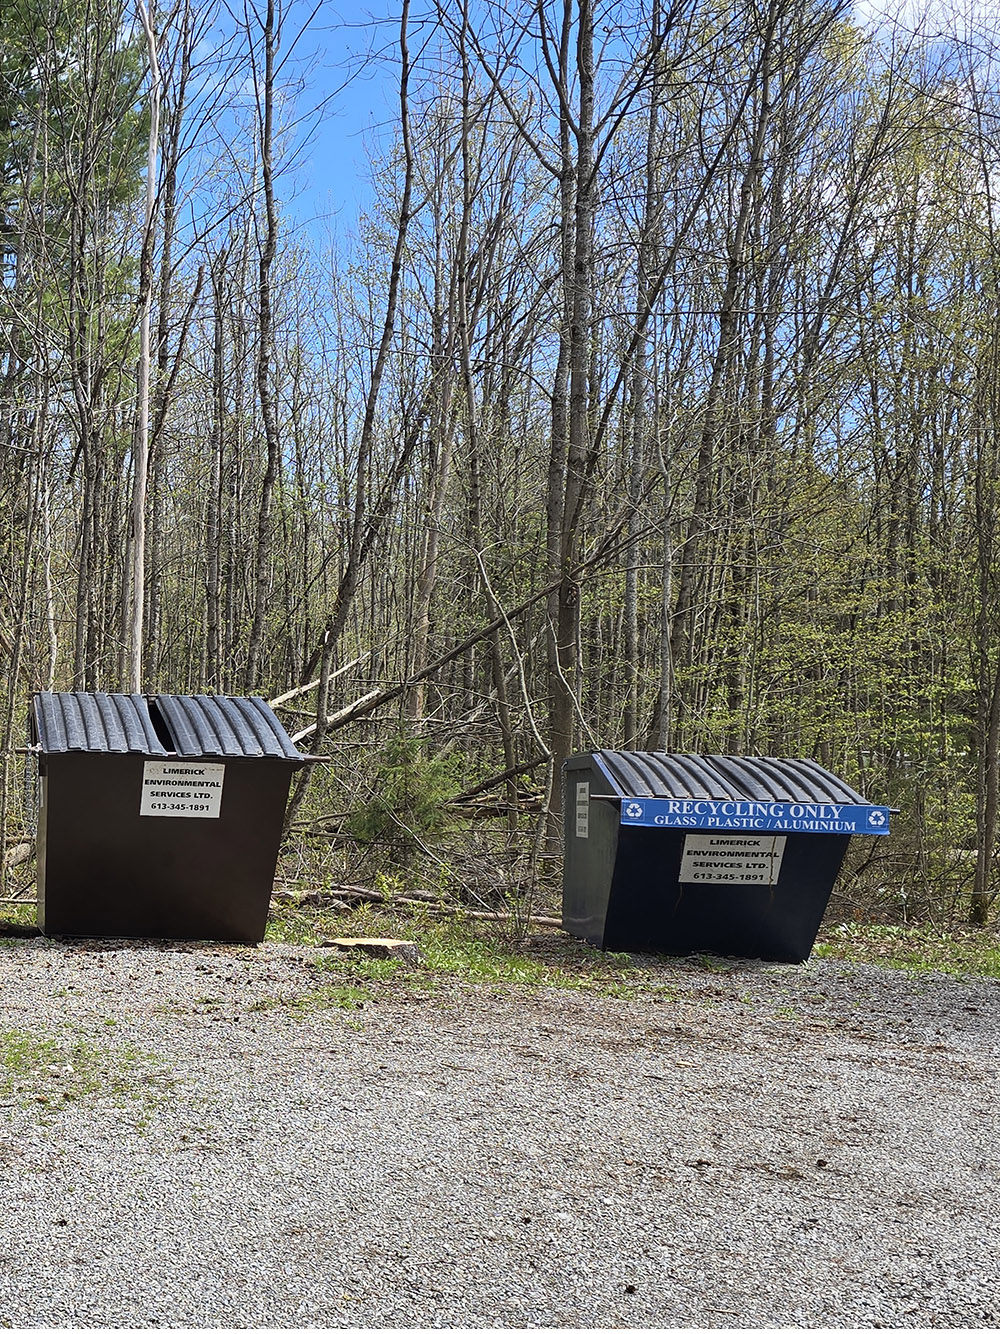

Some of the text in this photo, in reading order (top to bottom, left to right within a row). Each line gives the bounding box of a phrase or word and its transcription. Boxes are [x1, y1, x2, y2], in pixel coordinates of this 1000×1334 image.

[144, 779, 221, 787] ENVIRONMENTAL
[151, 803, 209, 811] 613-345-1891
[668, 801, 843, 819] RECYCLING ONLY
[654, 815, 697, 826] GLASS
[707, 818, 764, 829] PLASTIC
[773, 820, 856, 831] ALUMINIUM
[686, 850, 780, 858] ENVIRONMENTAL
